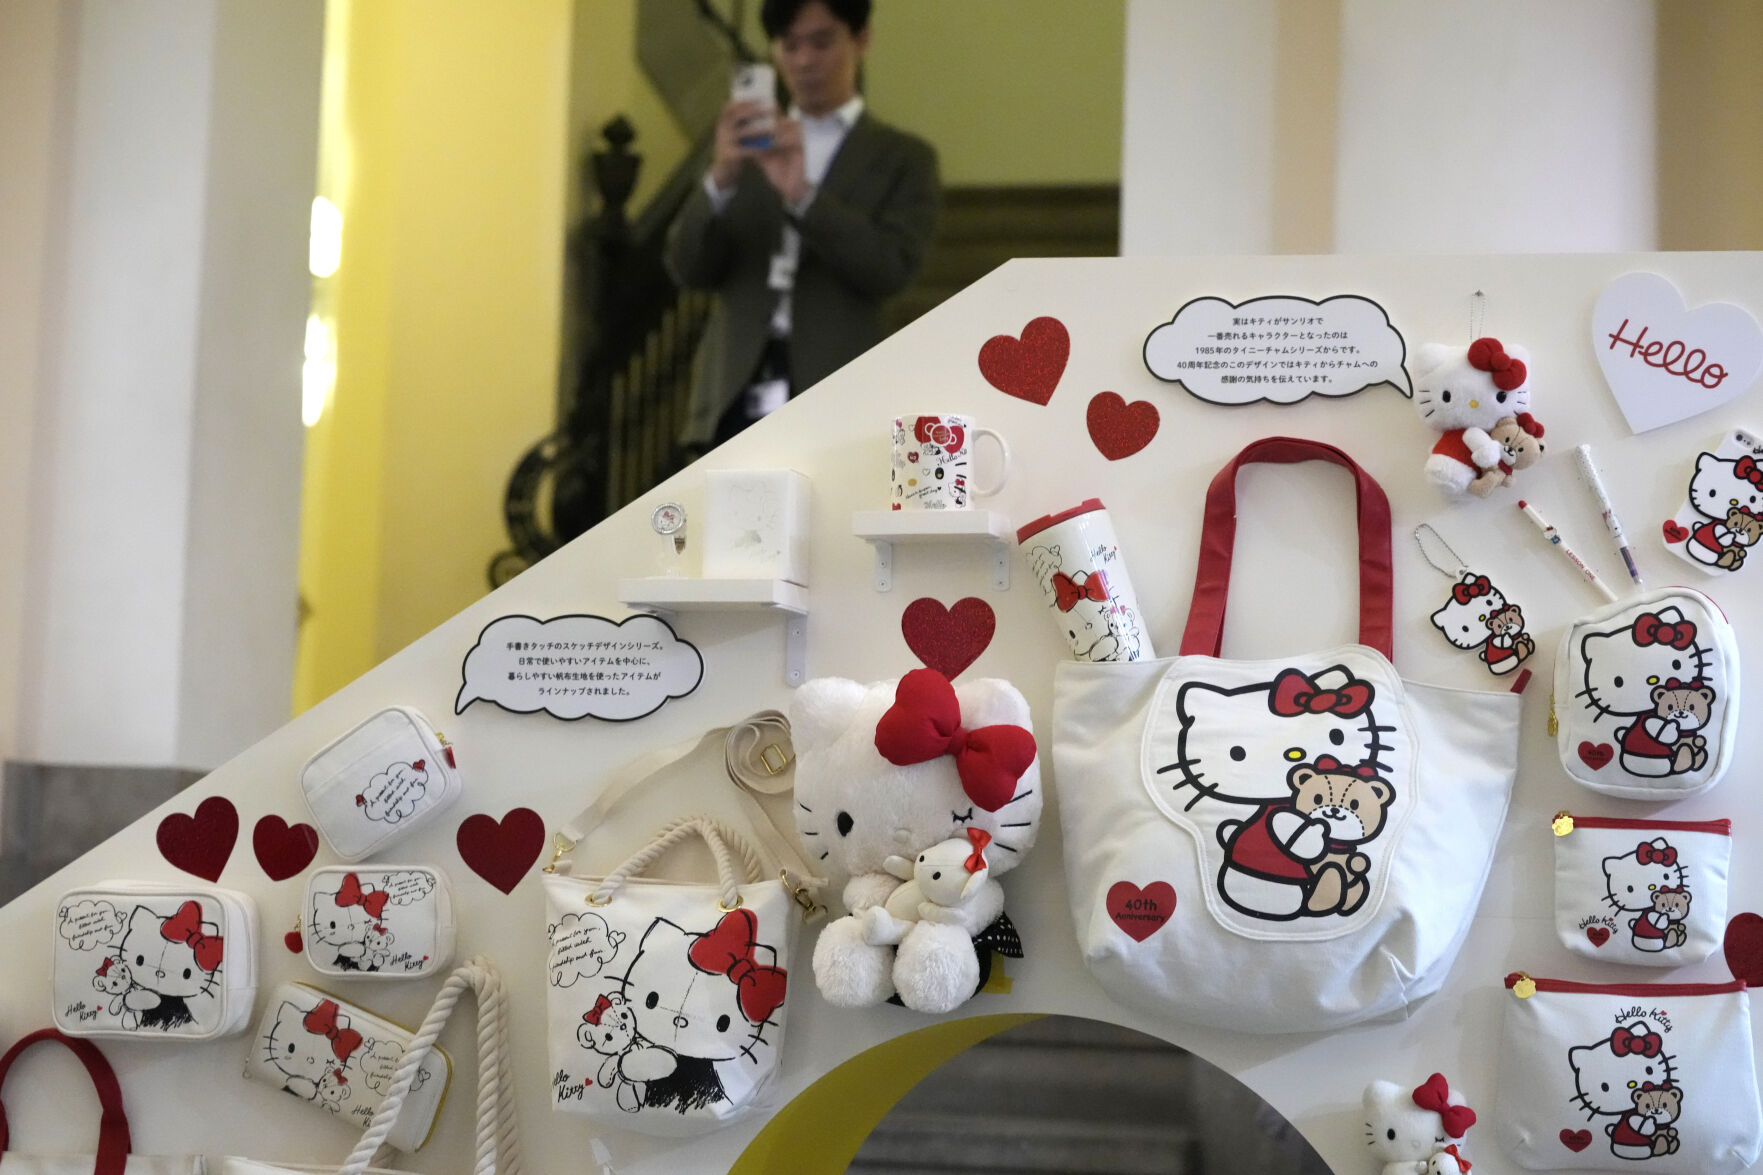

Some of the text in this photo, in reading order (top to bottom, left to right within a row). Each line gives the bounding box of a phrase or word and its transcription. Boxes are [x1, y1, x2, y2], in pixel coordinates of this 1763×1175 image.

[1232, 316, 1324, 327] 実はキティがサンリオで
[1207, 331, 1349, 342] 一番売れるキャラクターとなったのは
[1608, 318, 1728, 389] Hello
[1220, 374, 1334, 385] 感謝の気持ちを伝えています。
[538, 686, 631, 697] ラインナップされました。
[1125, 898, 1158, 911] 40th
[1115, 912, 1165, 922] Anniversary
[1579, 915, 1618, 935] Hello Kitty
[390, 952, 412, 966] Hello
[404, 959, 424, 972] Kitty
[65, 1001, 86, 1017] Hello
[79, 1009, 97, 1022] Kitty
[1614, 1006, 1673, 1034] Hello Kitty
[552, 1069, 570, 1087] ello
[558, 1083, 586, 1103] Kitty
[352, 1104, 375, 1117] Hello
